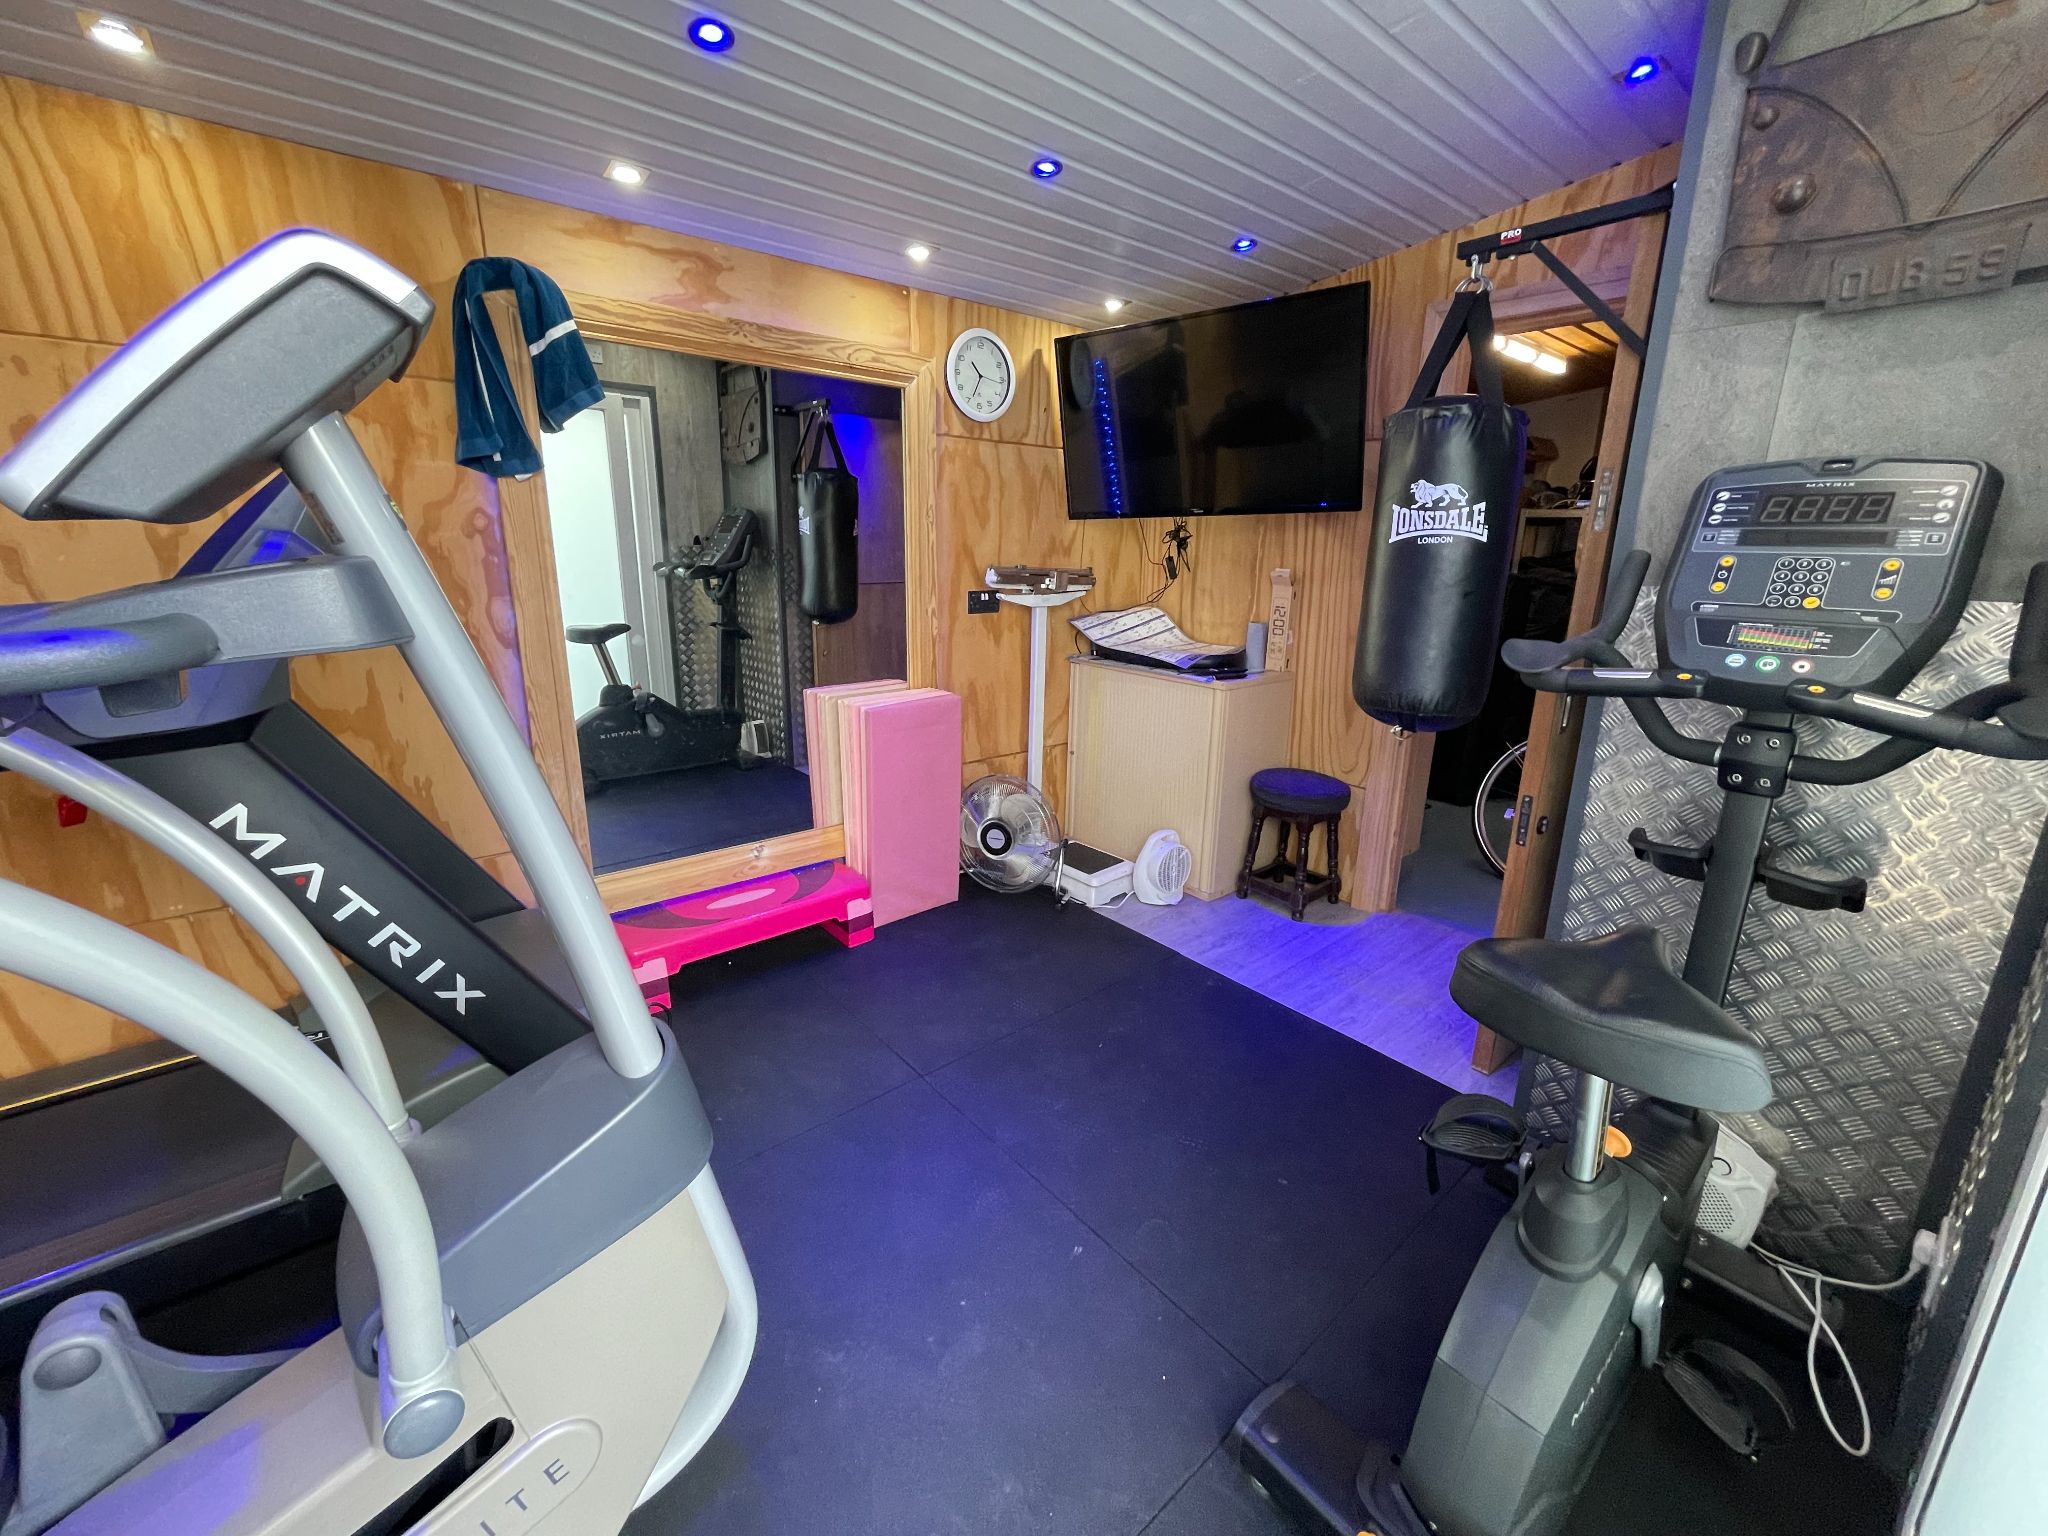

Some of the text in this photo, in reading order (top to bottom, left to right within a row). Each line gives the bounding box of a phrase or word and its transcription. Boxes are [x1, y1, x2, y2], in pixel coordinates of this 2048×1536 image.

[1501, 228, 1521, 240] PRO
[1389, 502, 1488, 543] LONSDALE
[1417, 536, 1453, 544] LONDON
[208, 802, 487, 1016] MATRIX
